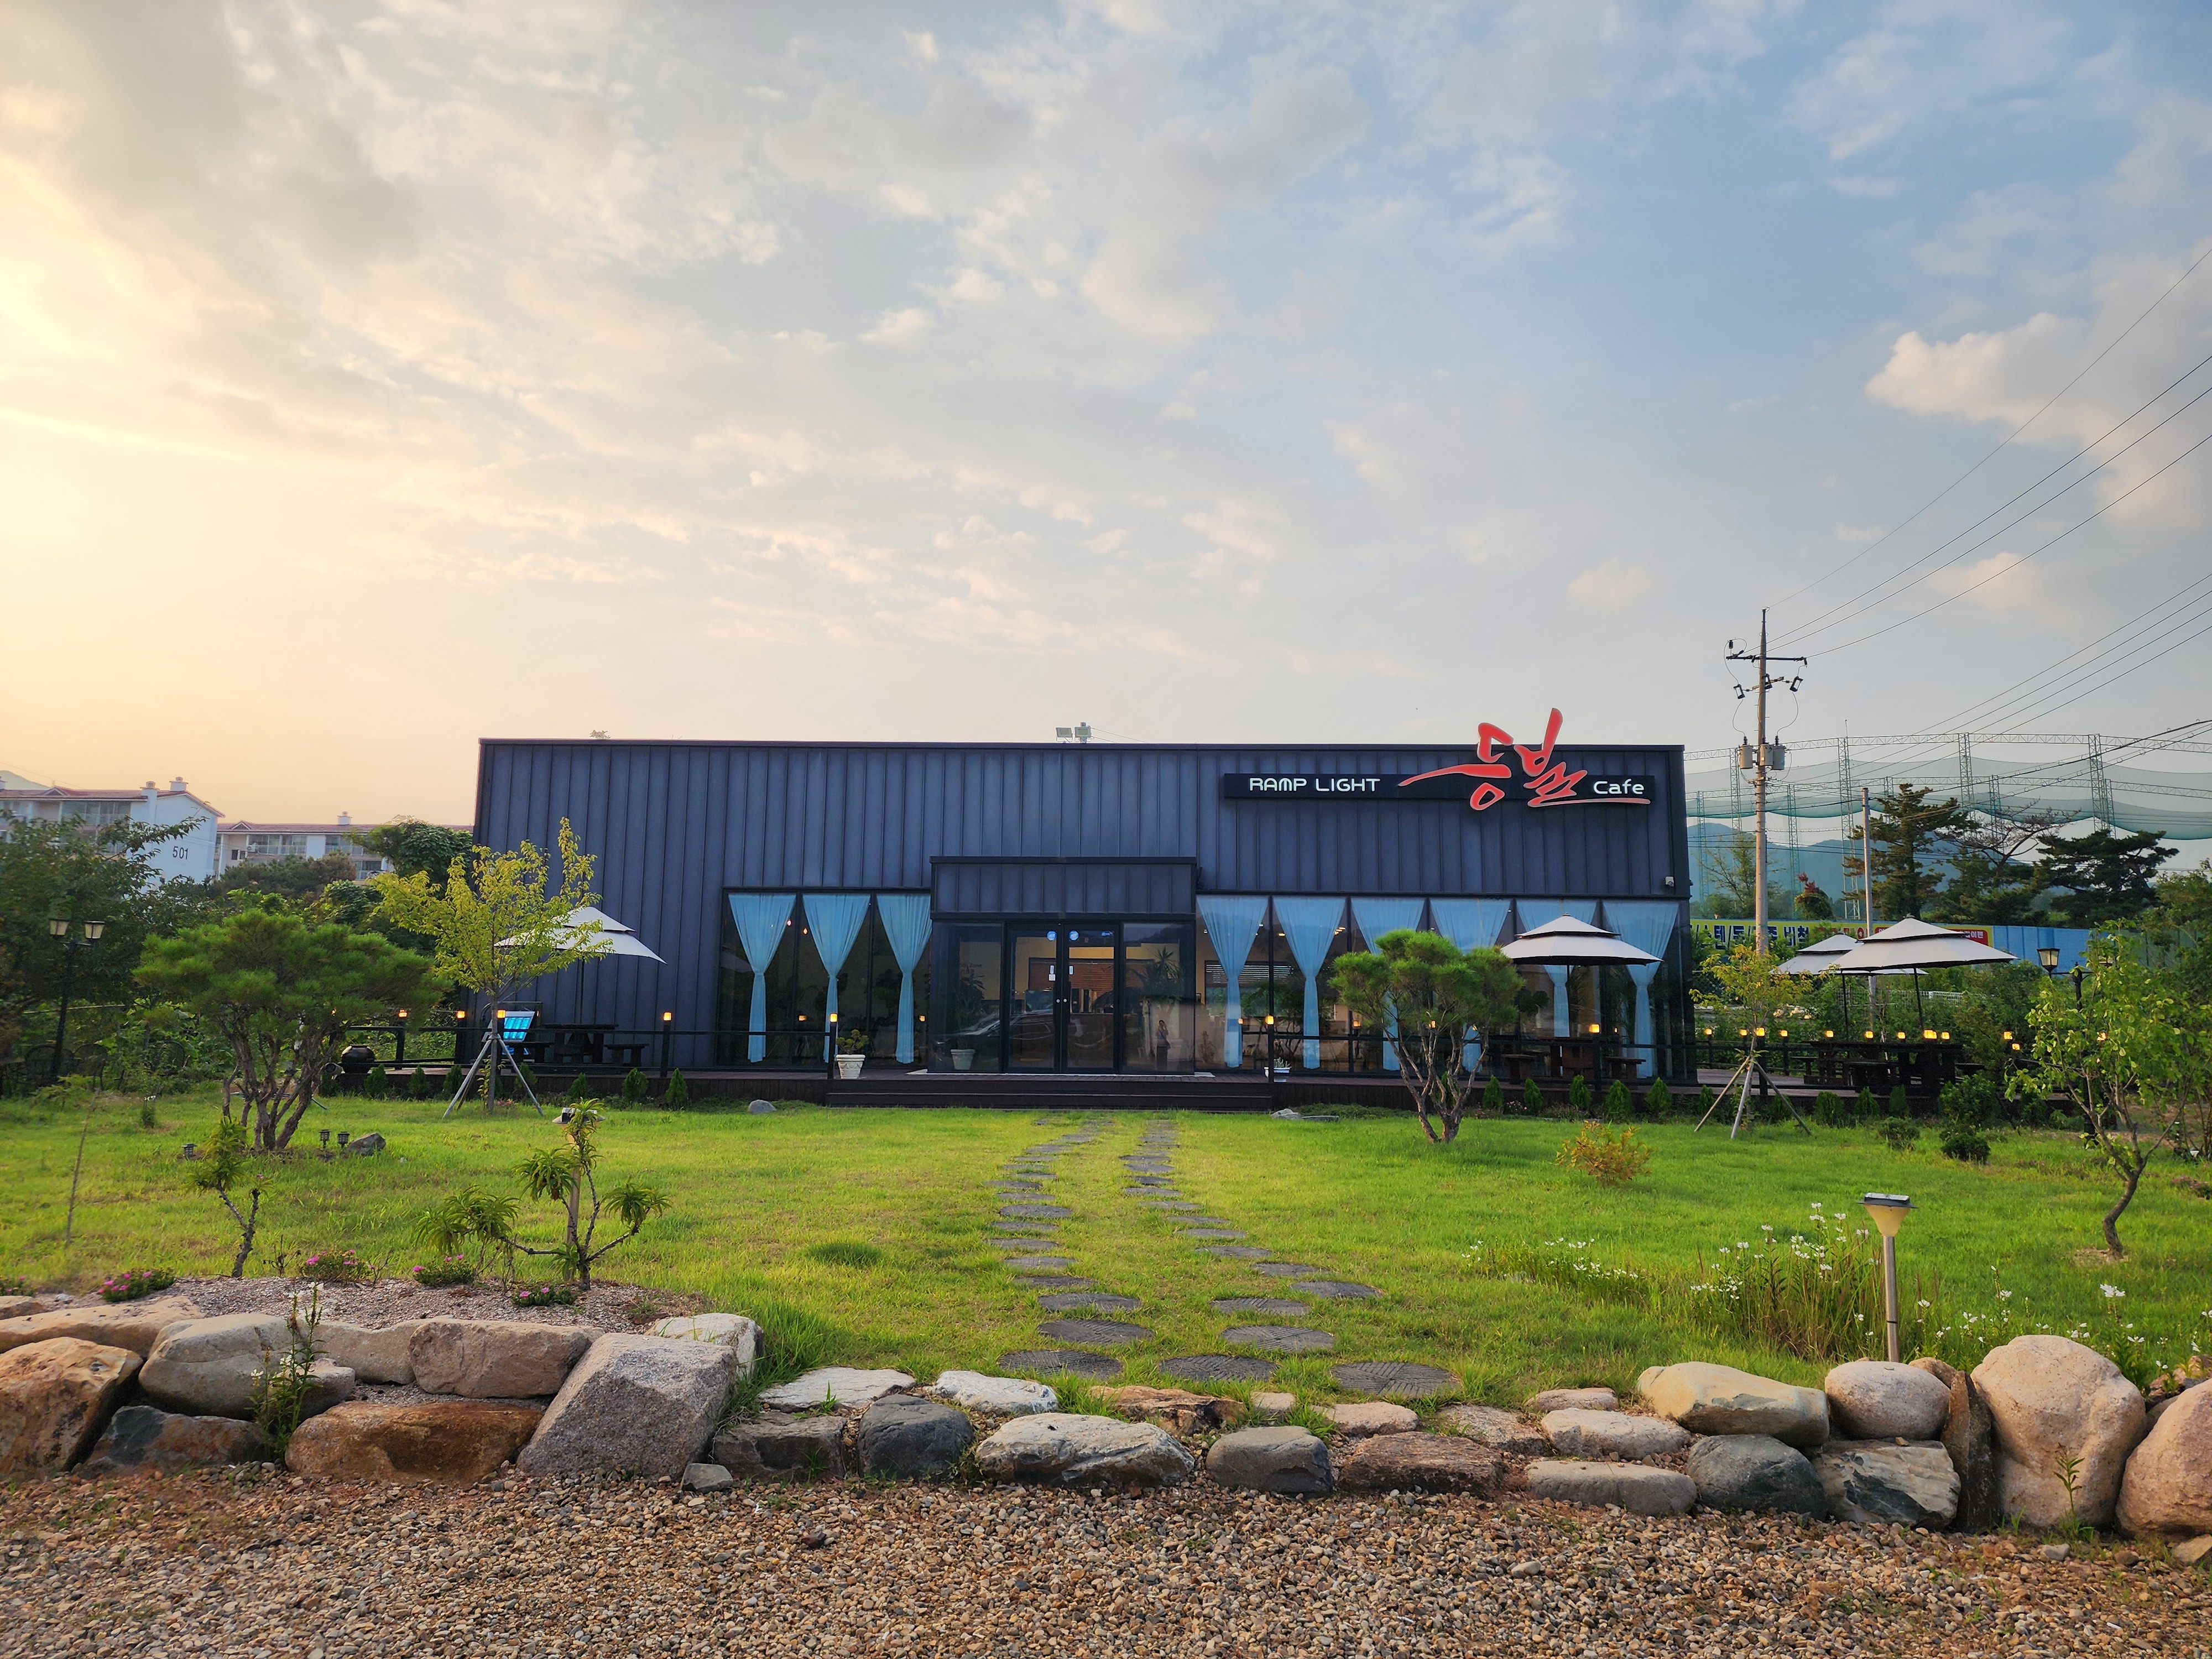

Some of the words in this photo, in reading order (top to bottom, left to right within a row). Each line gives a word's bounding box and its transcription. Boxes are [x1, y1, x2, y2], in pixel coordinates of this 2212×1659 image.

[1250, 778, 1307, 791] RAMP
[1316, 778, 1381, 792] LIGHT
[1593, 779, 1645, 795] Cafe
[173, 846, 188, 860] 501
